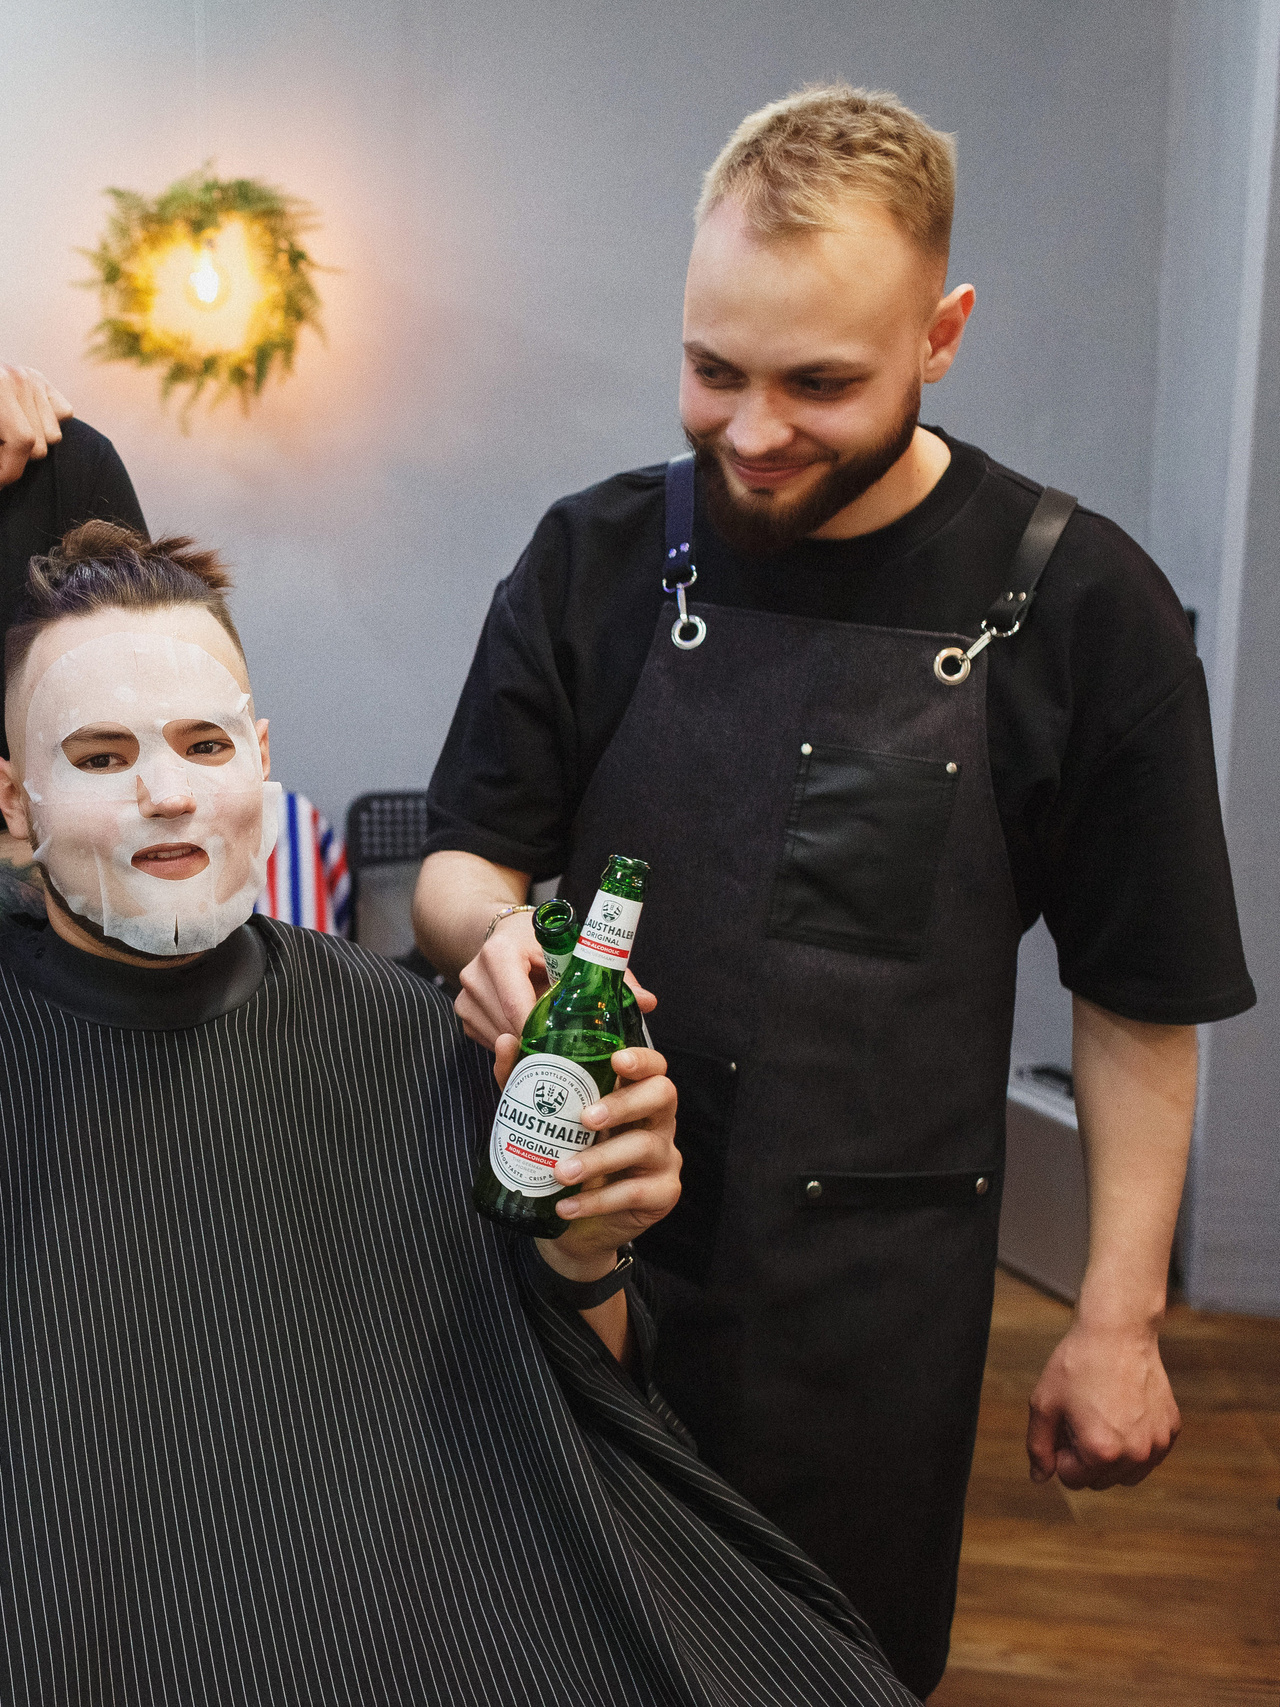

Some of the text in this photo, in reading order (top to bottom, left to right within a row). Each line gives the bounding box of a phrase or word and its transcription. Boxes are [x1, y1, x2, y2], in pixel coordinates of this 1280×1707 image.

[580, 938, 620, 956] NON-ALCOHOLIC
[586, 930, 620, 947] ORIGINAL
[515, 1073, 534, 1088] CRAFTED
[541, 1071, 567, 1083] BOTTLED
[498, 1099, 591, 1146] CLAUSTHALER
[508, 1133, 560, 1159] ORIGINAL
[498, 1136, 509, 1165] SUPERIOR
[507, 1165, 523, 1178] TASTE
[508, 1145, 554, 1167] NON-ALCOHOLIC
[515, 1163, 537, 1174] PIONEER
[521, 1160, 543, 1171] GERMAN
